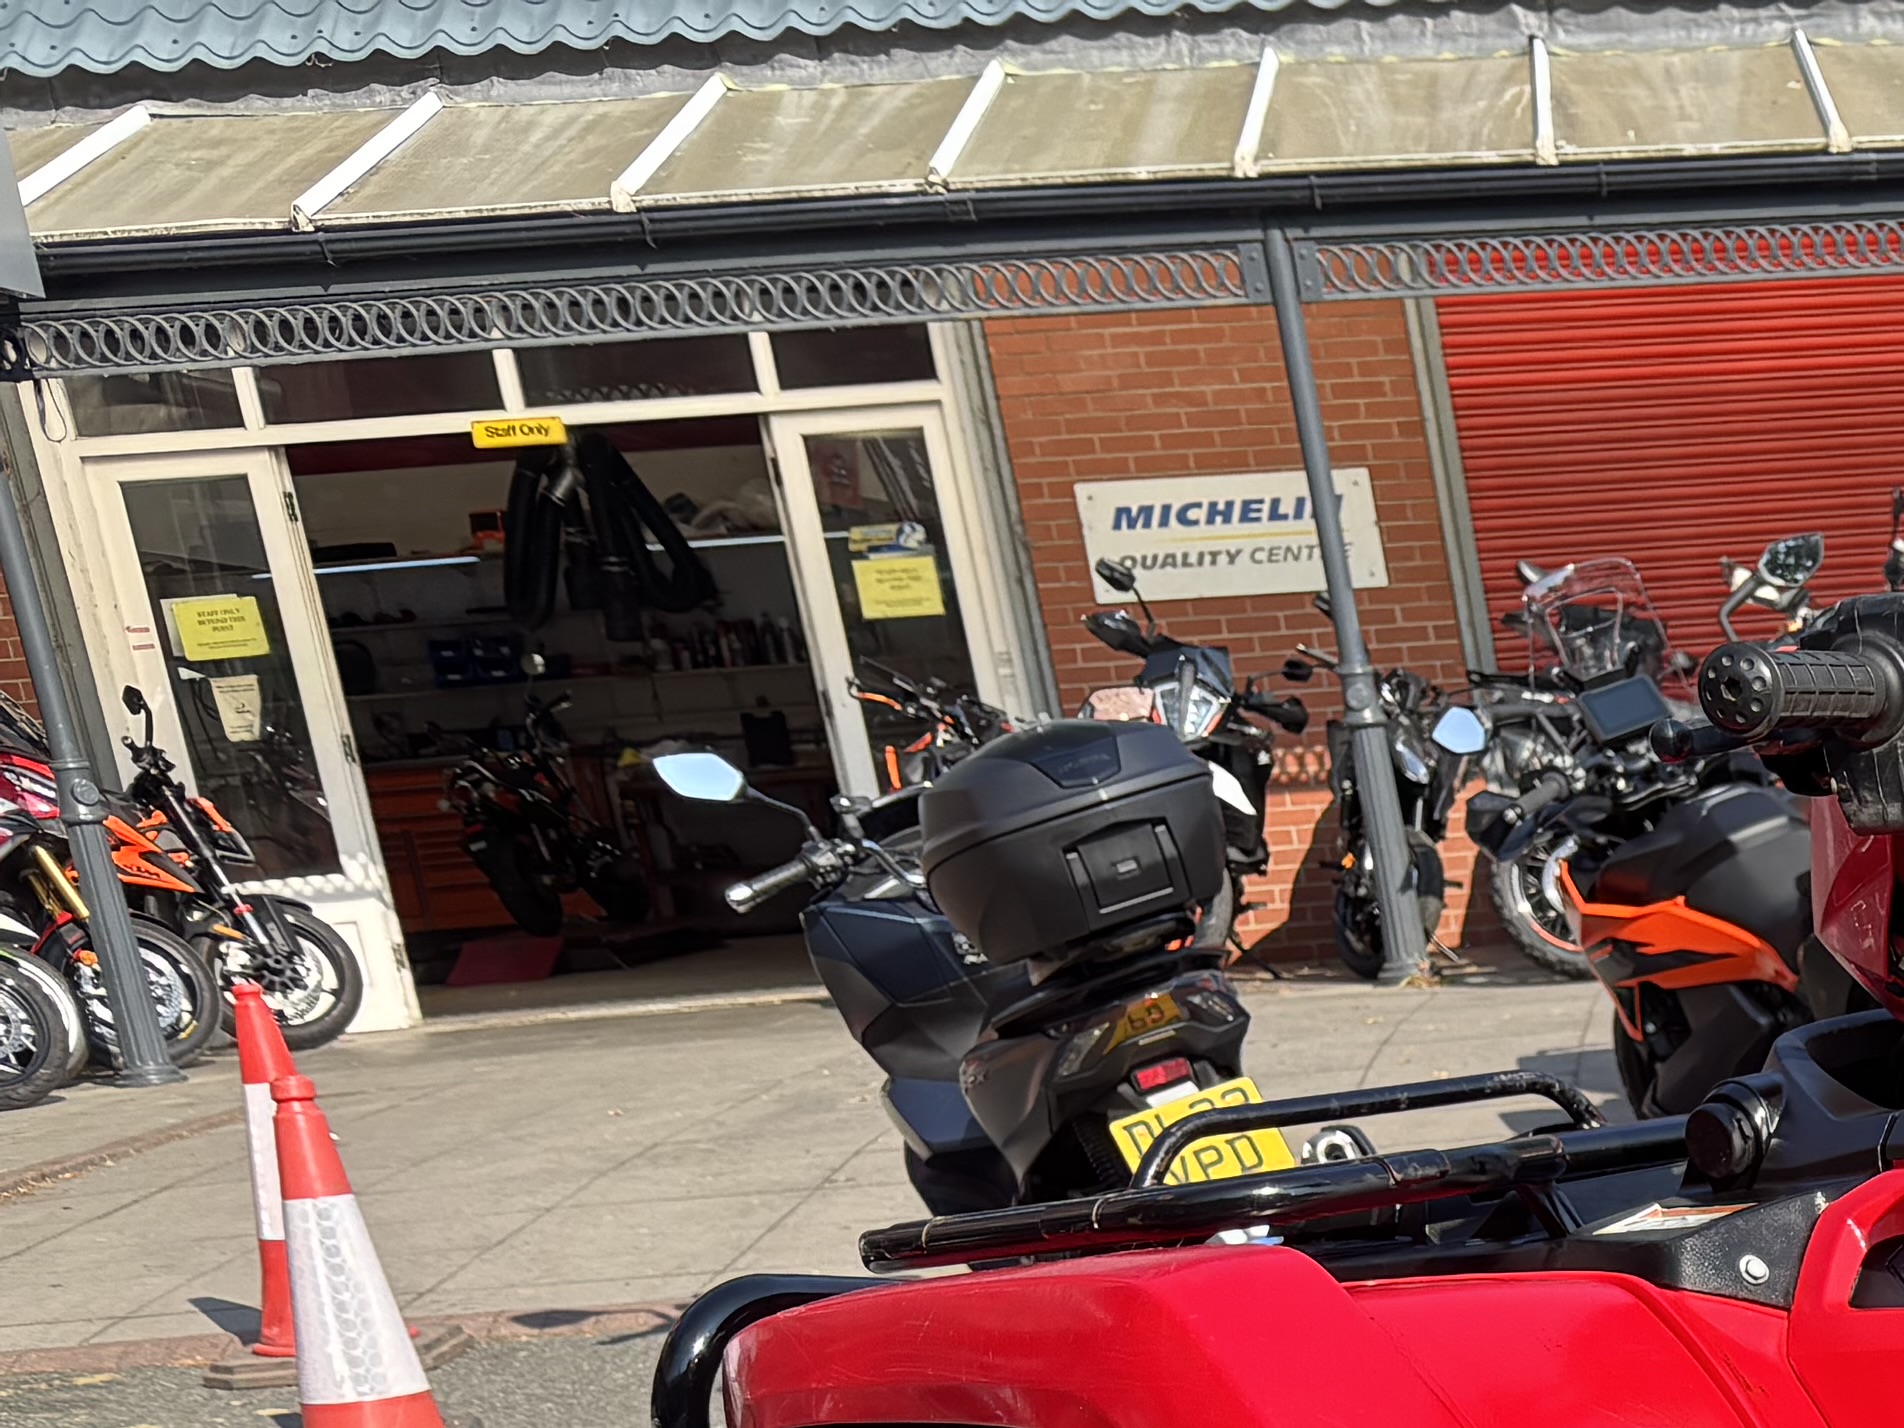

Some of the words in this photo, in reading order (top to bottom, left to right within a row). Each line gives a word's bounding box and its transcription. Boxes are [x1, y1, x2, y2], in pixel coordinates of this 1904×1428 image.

[484, 424, 517, 438] Staff
[519, 423, 550, 437] Only
[1118, 548, 1244, 571] QUALITY
[1250, 542, 1353, 565] CENT
